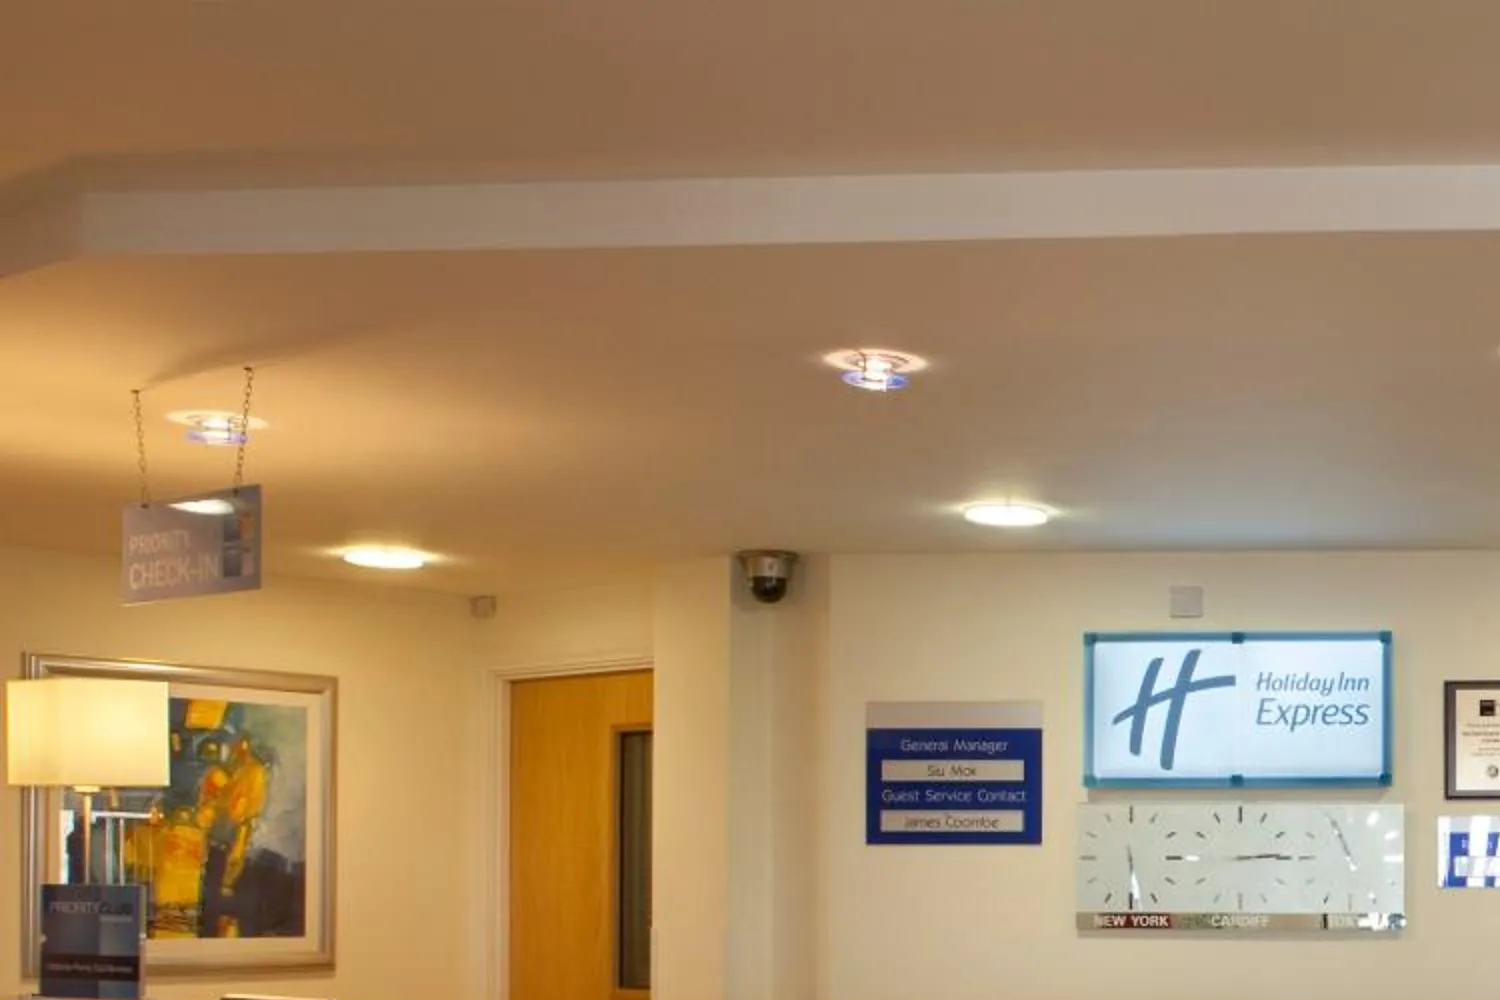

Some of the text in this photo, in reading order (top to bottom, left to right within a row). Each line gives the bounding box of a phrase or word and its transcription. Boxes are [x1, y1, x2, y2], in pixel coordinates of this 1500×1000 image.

[129, 529, 191, 556] PRIORITY
[129, 552, 219, 590] CHECK-IN
[1256, 671, 1371, 697] Holiday Inn
[1256, 697, 1371, 732] Express
[900, 738, 1009, 755] General Manager
[881, 787, 1026, 803] Guest Service Contact
[1094, 912, 1126, 929] NEW
[1130, 912, 1169, 929] YORK
[1210, 912, 1270, 930] CARDIFF
